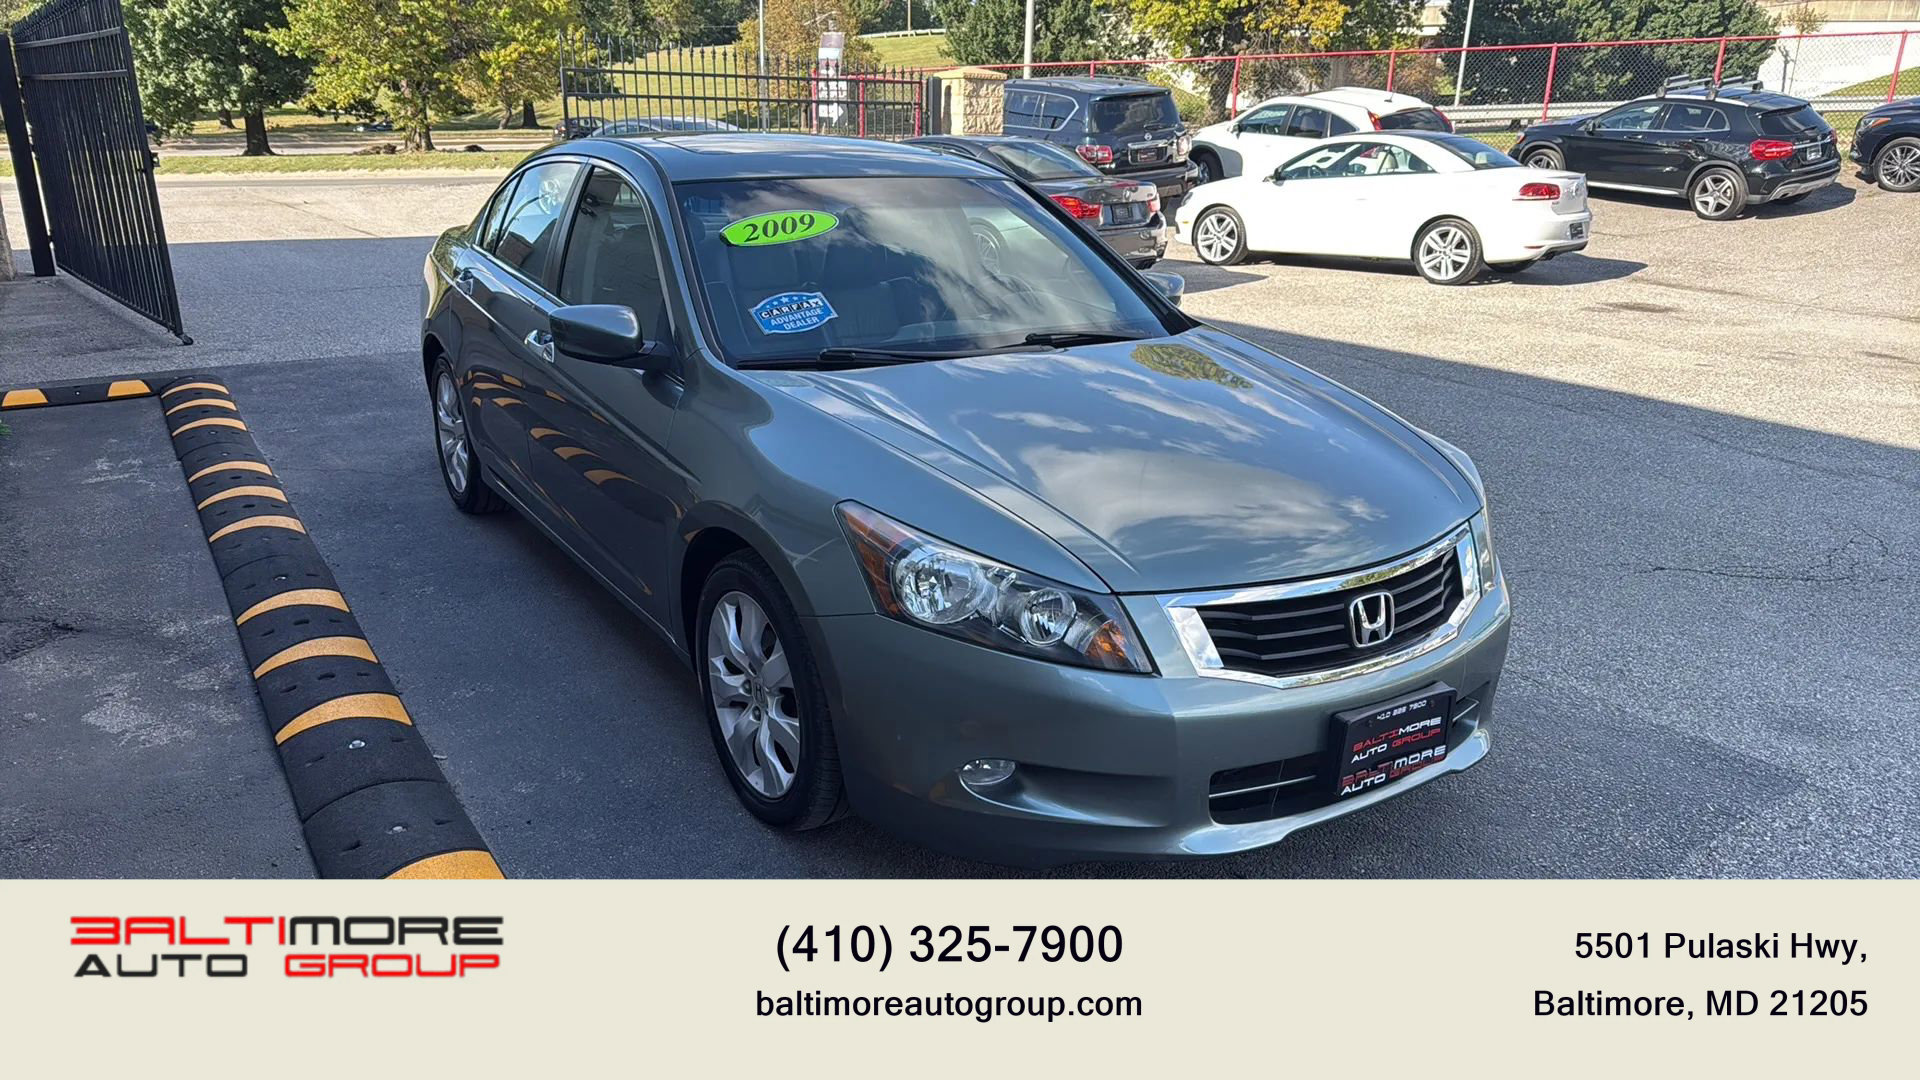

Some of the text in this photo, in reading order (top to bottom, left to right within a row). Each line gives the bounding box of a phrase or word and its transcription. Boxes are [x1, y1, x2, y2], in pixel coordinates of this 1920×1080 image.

[742, 213, 815, 242] 2009
[760, 299, 823, 319] CARFAX
[770, 308, 824, 326] ADVANTAGE
[783, 316, 820, 330] DEALER
[1351, 728, 1441, 764] AUTO GROUP
[1353, 717, 1442, 753] BALTIMORE
[1341, 773, 1386, 796] AUTO
